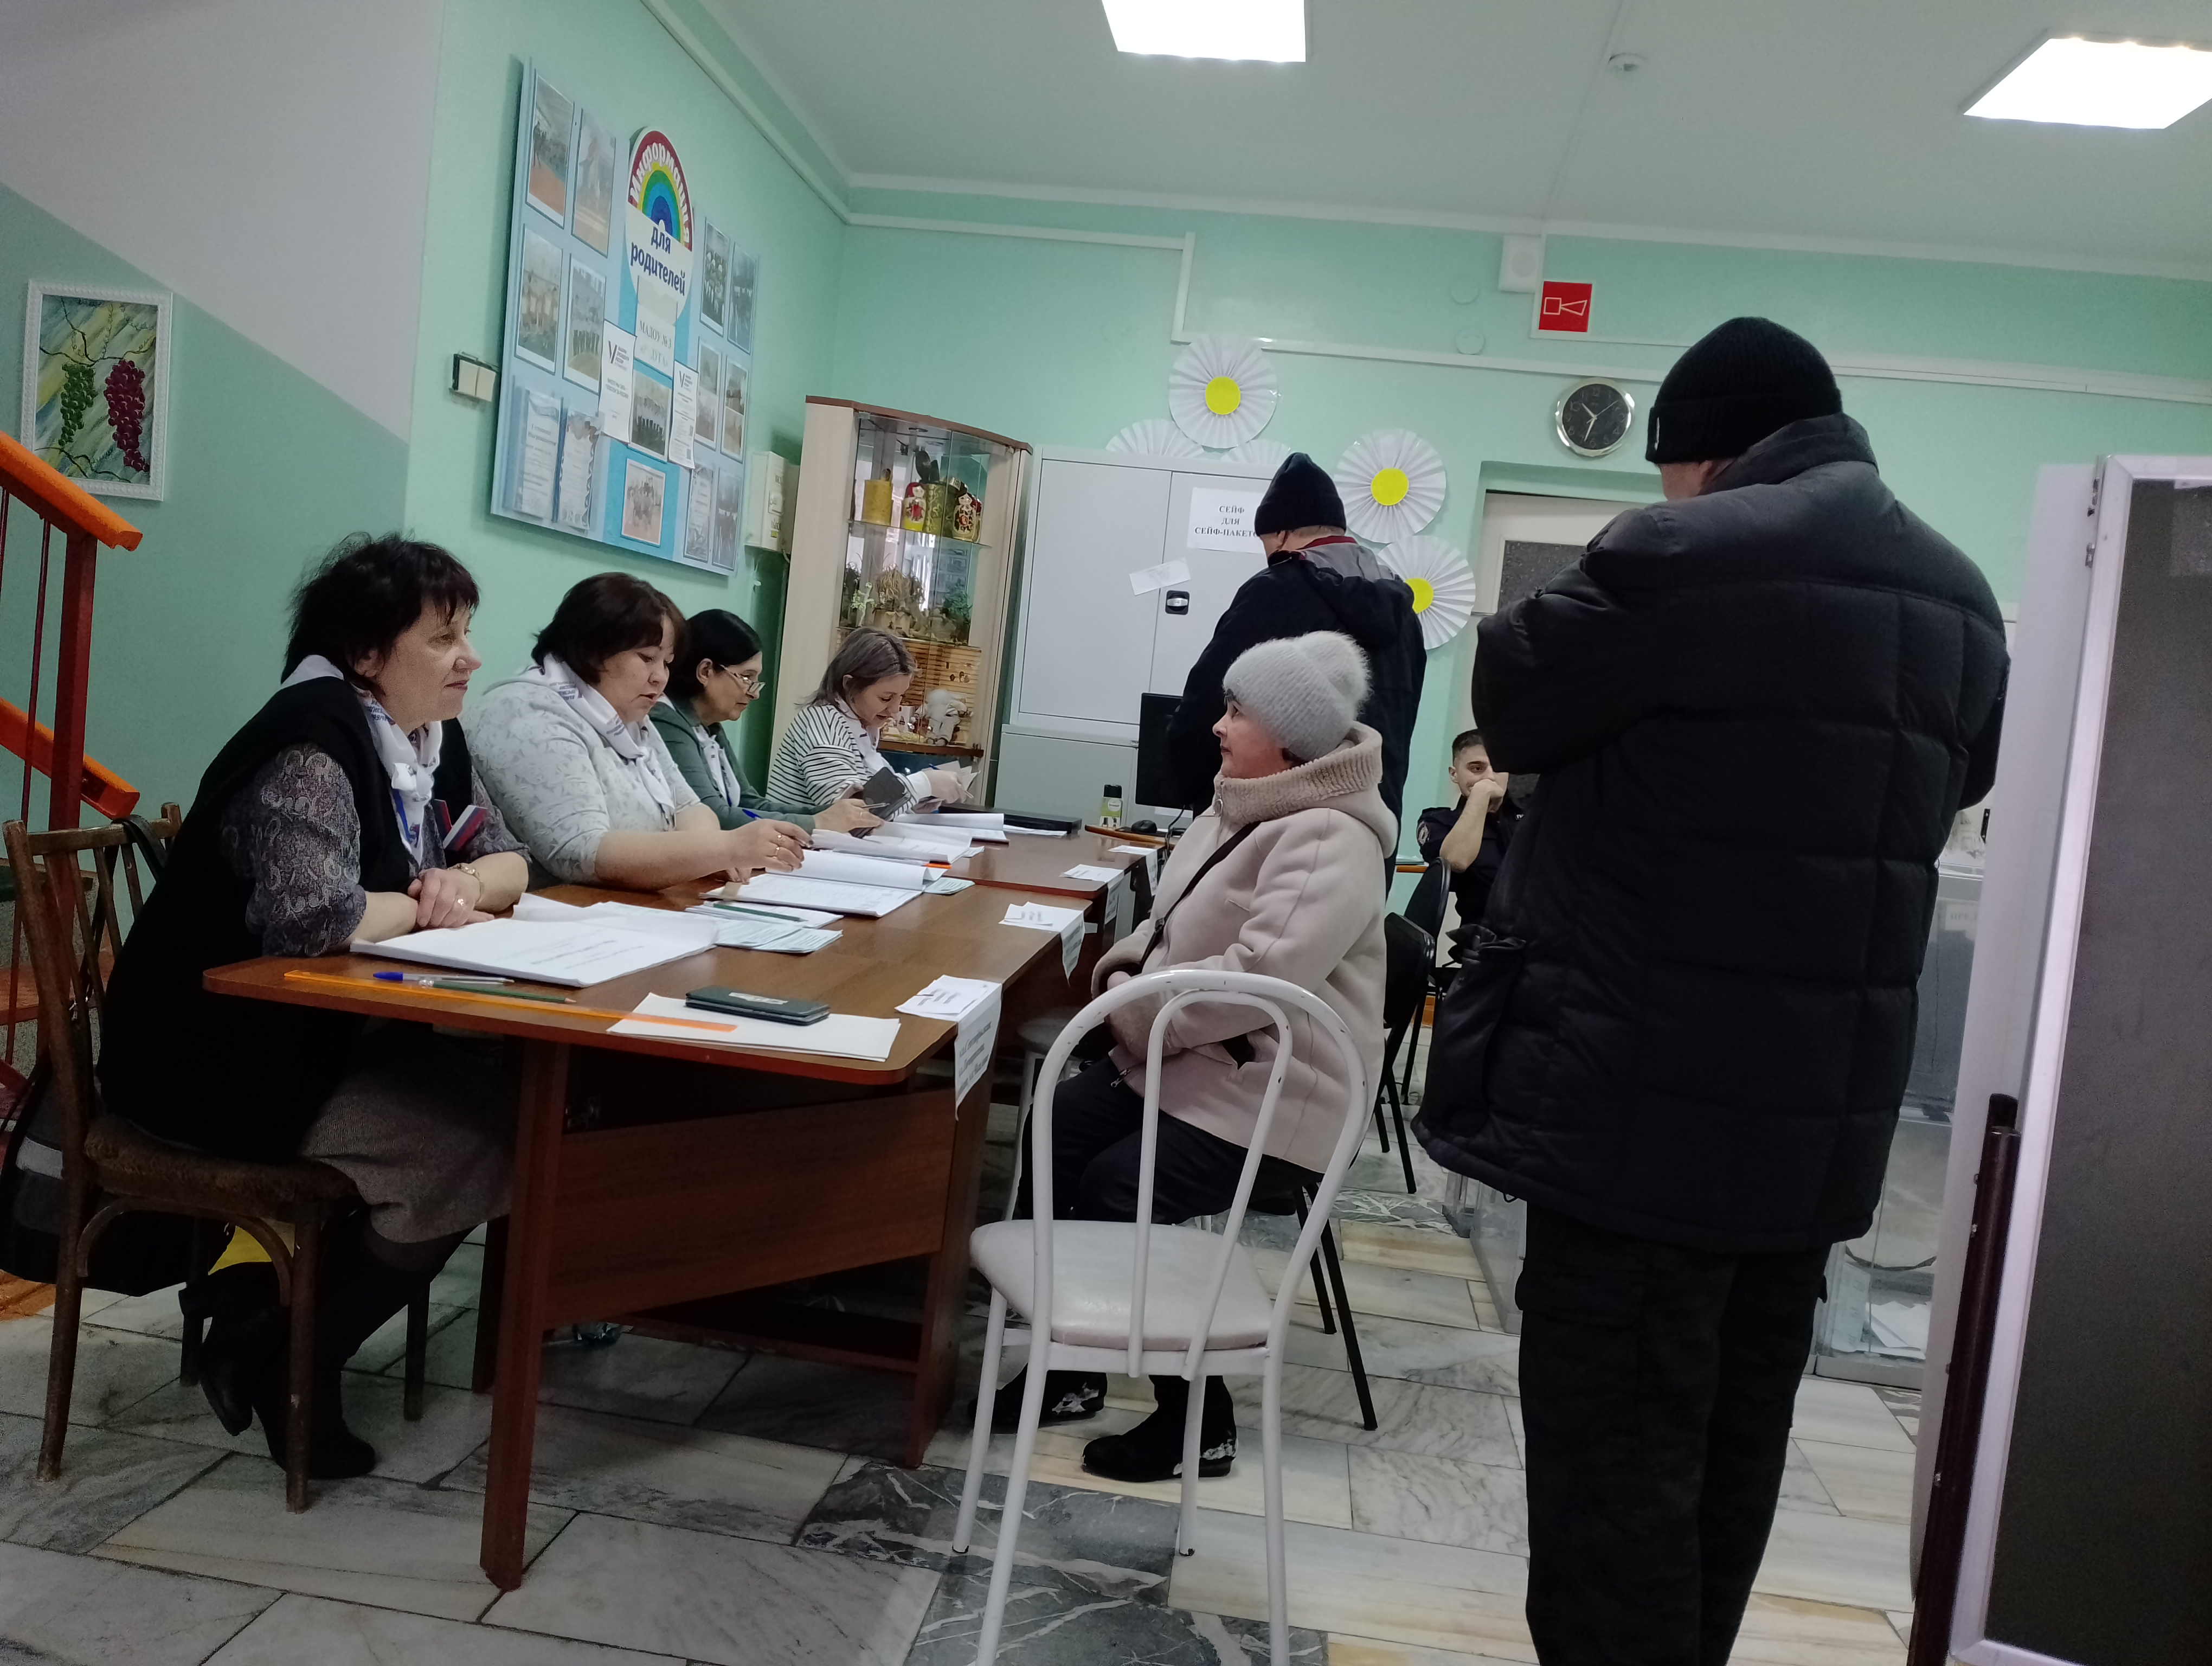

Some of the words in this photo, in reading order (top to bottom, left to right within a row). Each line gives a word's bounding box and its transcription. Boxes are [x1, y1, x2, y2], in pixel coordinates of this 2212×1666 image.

[630, 142, 690, 243] Информация
[651, 226, 671, 254] для
[631, 242, 685, 296] родителей
[640, 320, 660, 342] МАДОУ
[1219, 505, 1245, 514] СЕЙФ
